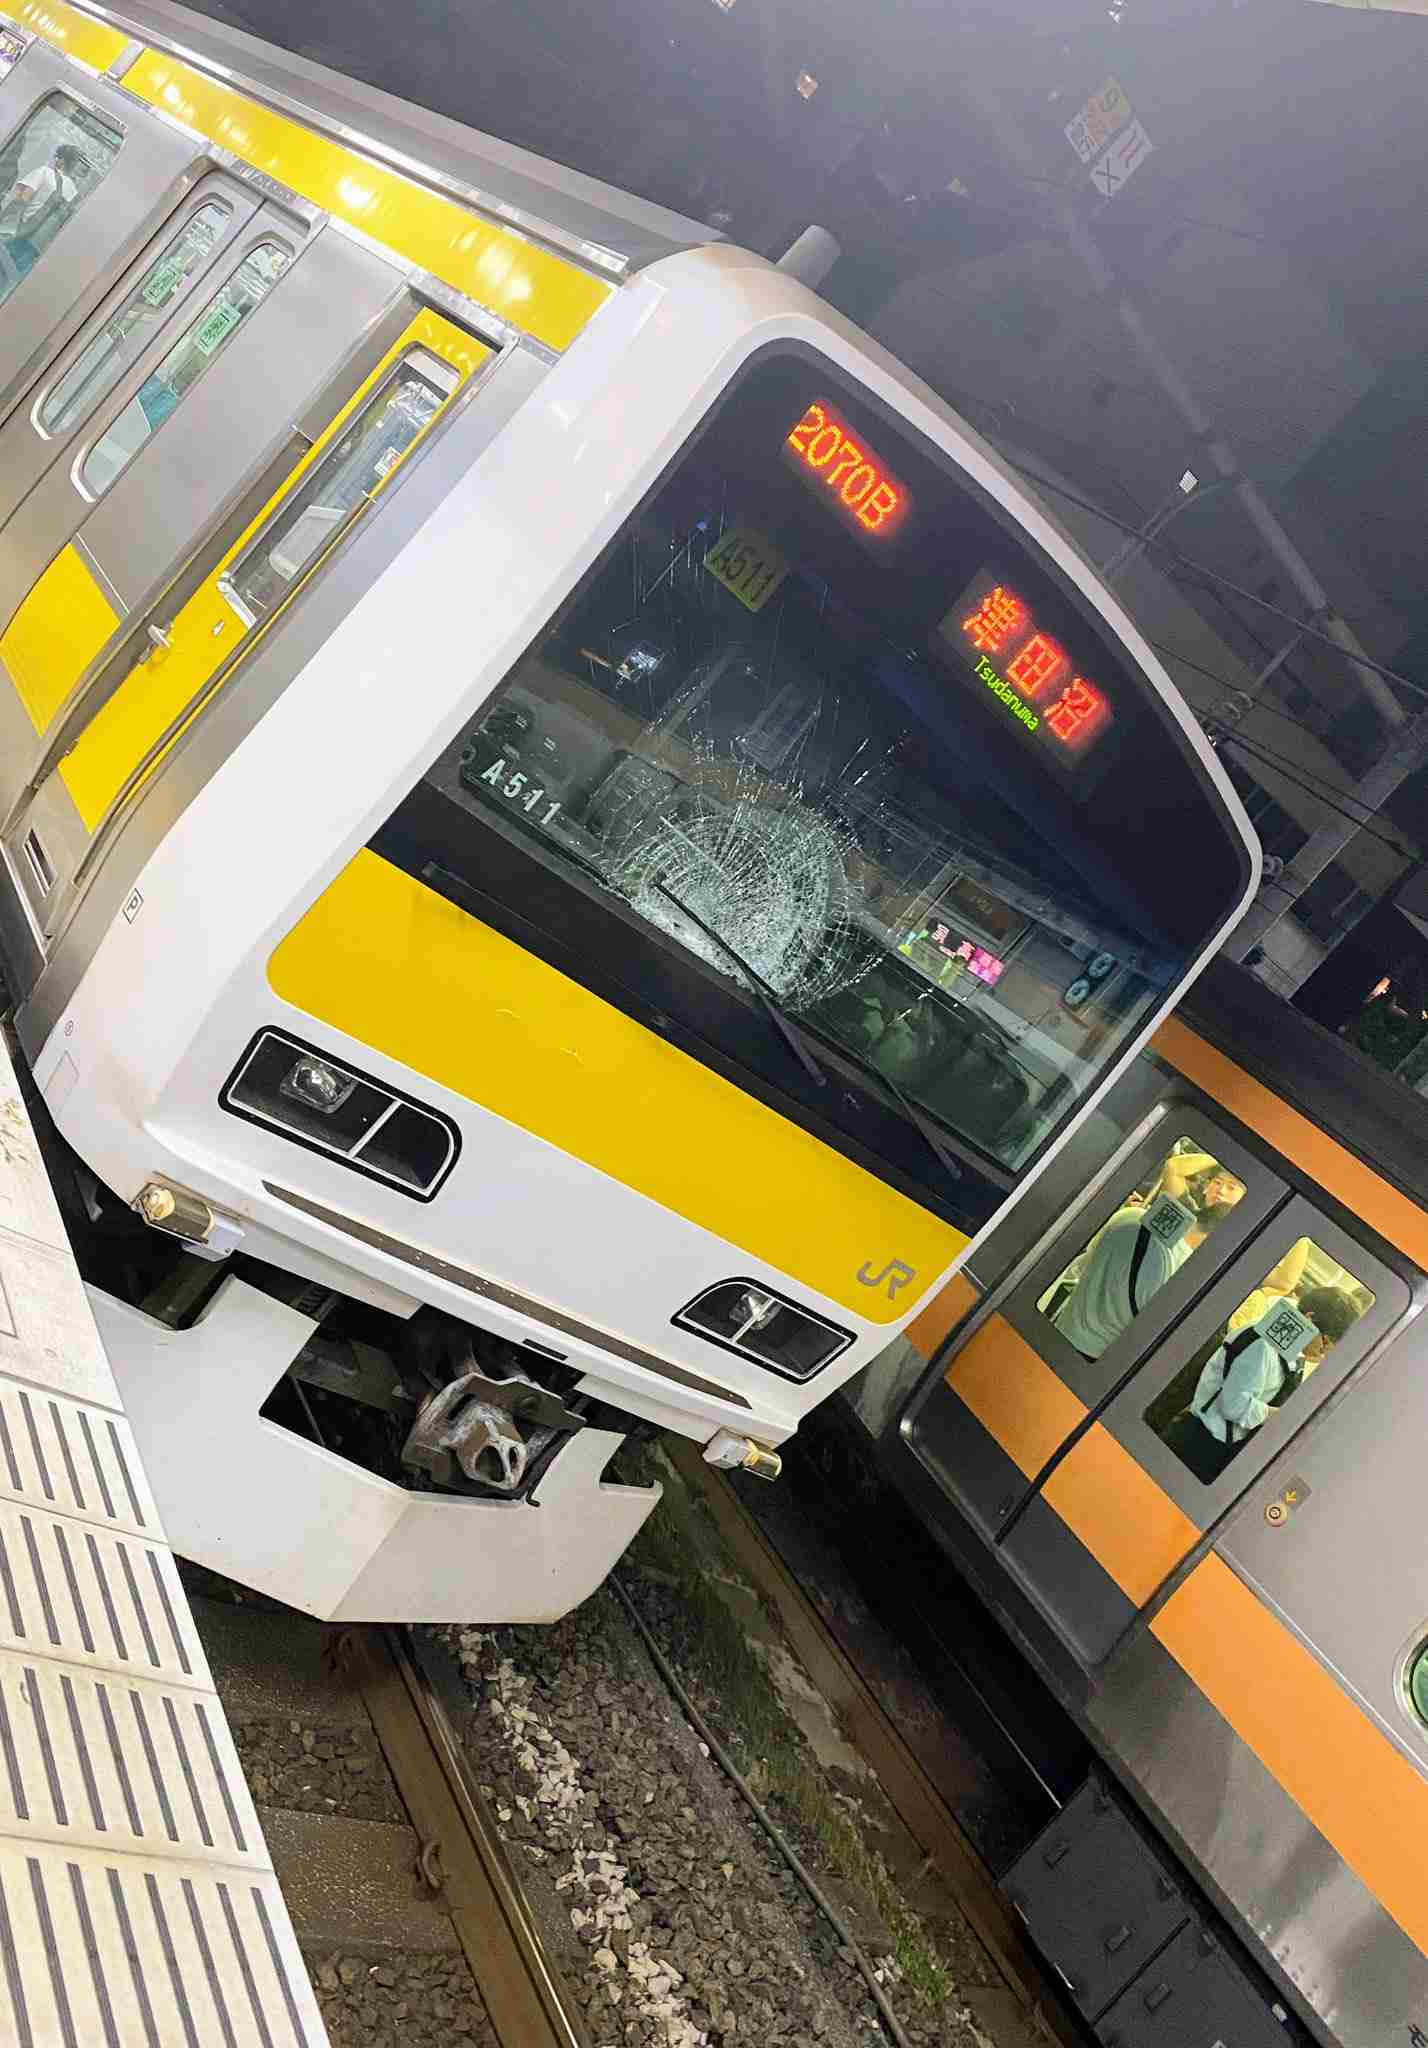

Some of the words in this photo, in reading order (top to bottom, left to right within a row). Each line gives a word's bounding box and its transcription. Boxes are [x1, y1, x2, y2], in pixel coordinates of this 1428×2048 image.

[788, 404, 898, 529] 2070B
[709, 541, 776, 602] A511
[962, 586, 1101, 741] 津田沼
[974, 655, 1041, 732] Tsudanuma
[480, 759, 561, 825] A511
[856, 1257, 916, 1300] JR
